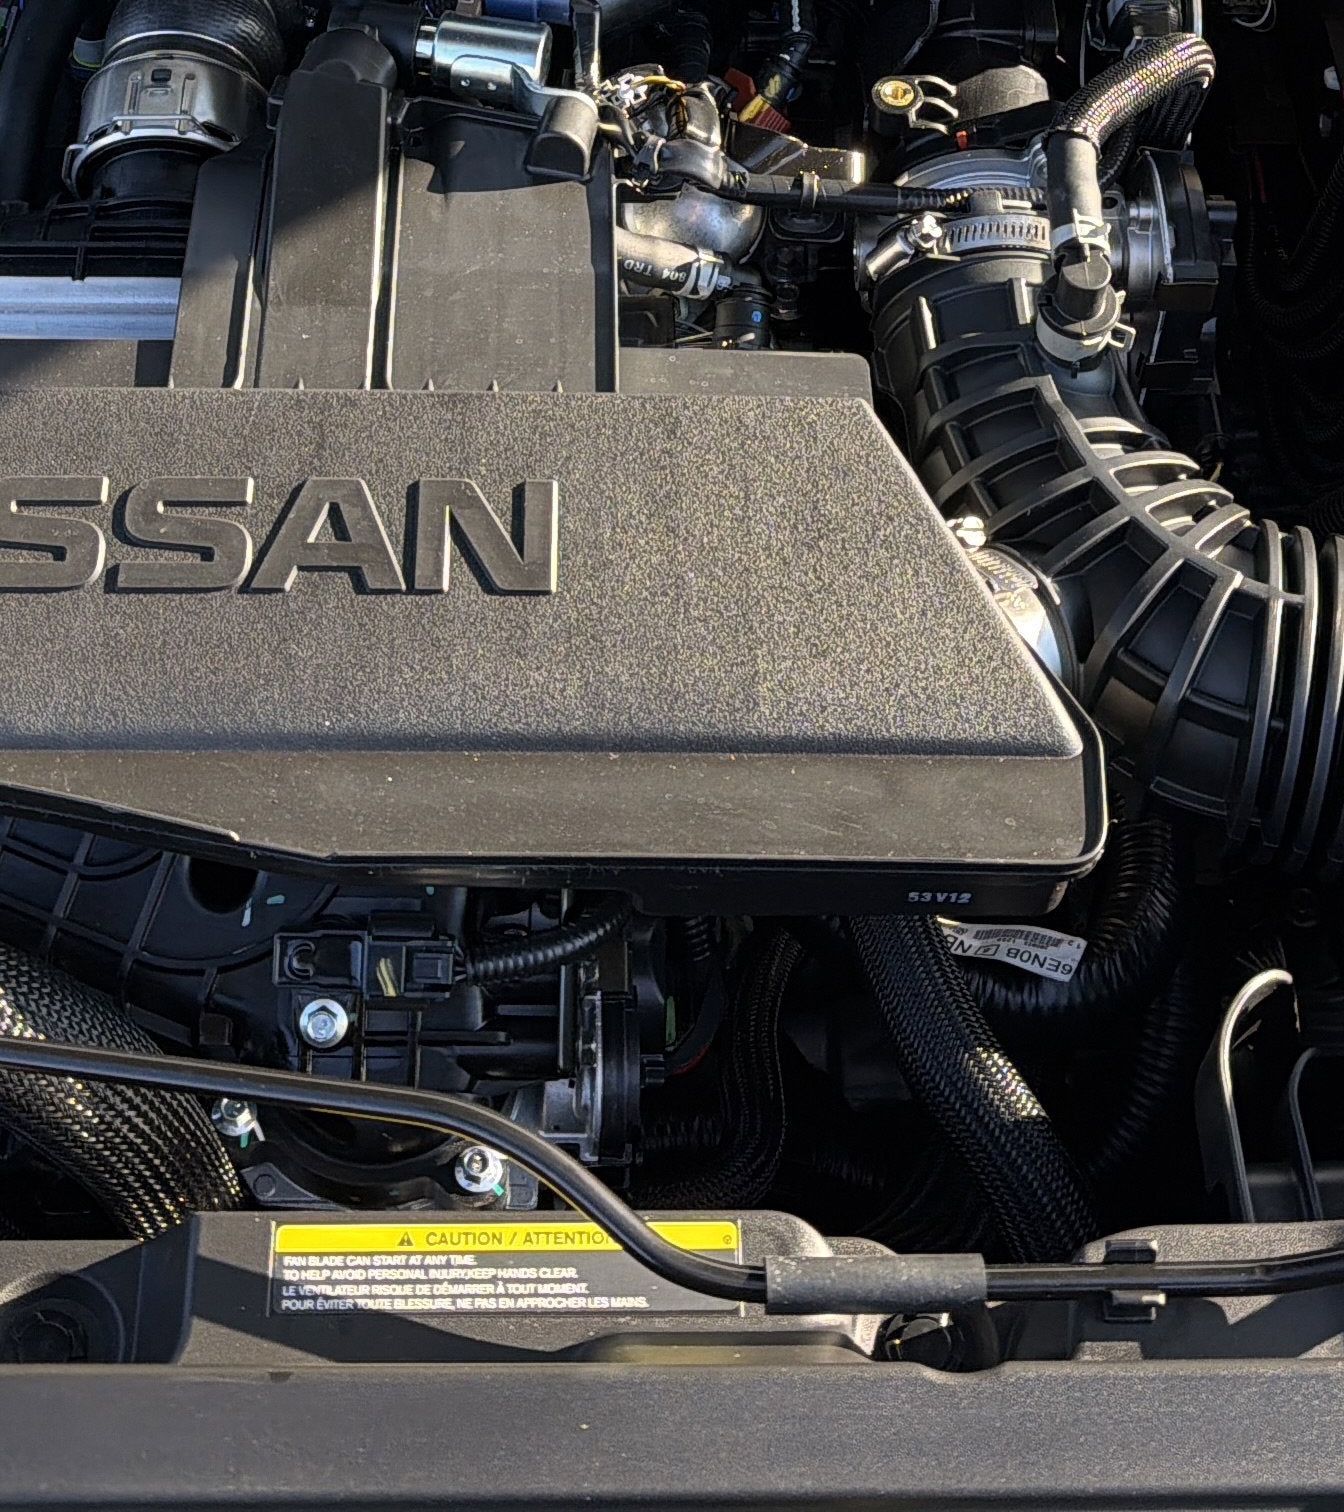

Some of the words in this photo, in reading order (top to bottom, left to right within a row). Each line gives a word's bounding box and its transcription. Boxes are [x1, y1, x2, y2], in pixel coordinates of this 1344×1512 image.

[623, 259, 653, 277] TRD
[908, 892, 932, 903] 53
[936, 892, 972, 904] V12
[425, 1231, 502, 1246] CAUTION
[522, 1231, 615, 1246] ATTENTIO
[283, 1255, 306, 1267] FAN
[308, 1255, 344, 1267] BLADE
[346, 1255, 371, 1267] CAN
[372, 1255, 406, 1267] START
[408, 1255, 423, 1267] AT
[423, 1255, 449, 1267] ANY
[449, 1255, 477, 1266] TIME.
[282, 1269, 299, 1281] TO
[301, 1269, 331, 1281] HELP
[331, 1269, 366, 1281] AVOID
[367, 1268, 428, 1280] PERSONAL
[497, 1268, 537, 1279] HANDS
[538, 1268, 578, 1279] CLEAR.
[282, 1285, 297, 1297] LE
[298, 1285, 370, 1297] VENTILATEUR
[372, 1284, 414, 1296] RISQUE
[416, 1284, 433, 1296] DE
[435, 1281, 494, 1295] DÉMARRER
[495, 1281, 506, 1294] À
[507, 1284, 537, 1294] TOUT
[281, 1299, 316, 1310] POUR
[317, 1296, 354, 1310] ÉVITER
[355, 1298, 392, 1310] TOUTE
[457, 1298, 474, 1309] NE
[474, 1298, 497, 1309] PAS
[498, 1298, 516, 1309] EN
[516, 1297, 587, 1309] APPROCHER
[587, 1297, 609, 1308] LES
